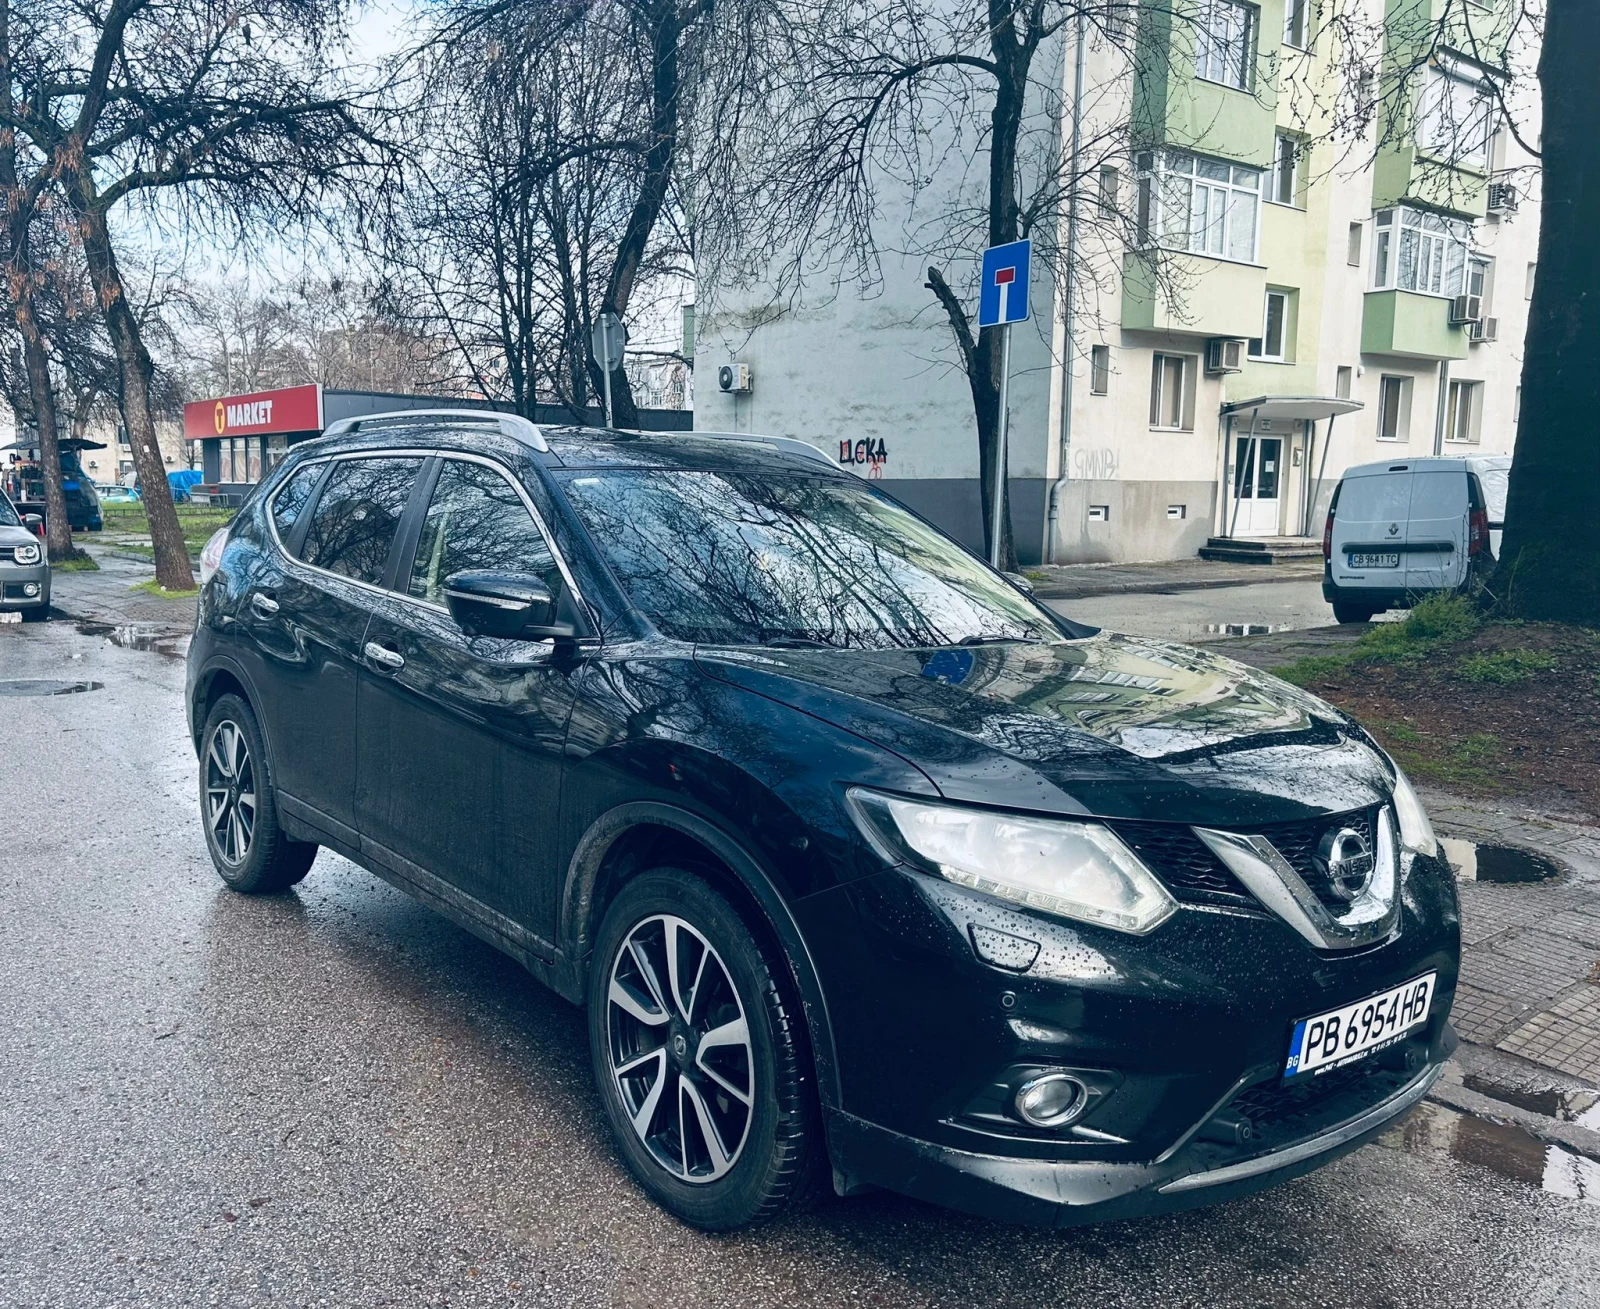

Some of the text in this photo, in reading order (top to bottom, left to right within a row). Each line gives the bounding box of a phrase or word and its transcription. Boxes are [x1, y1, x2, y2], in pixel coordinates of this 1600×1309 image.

[227, 400, 272, 427] MARKET
[1354, 555, 1396, 564] CB 9641 TC
[1304, 1016, 1341, 1064] PB
[1344, 992, 1400, 1049] 6954
[1400, 981, 1428, 1027] HB
[1287, 1055, 1299, 1069] BG
